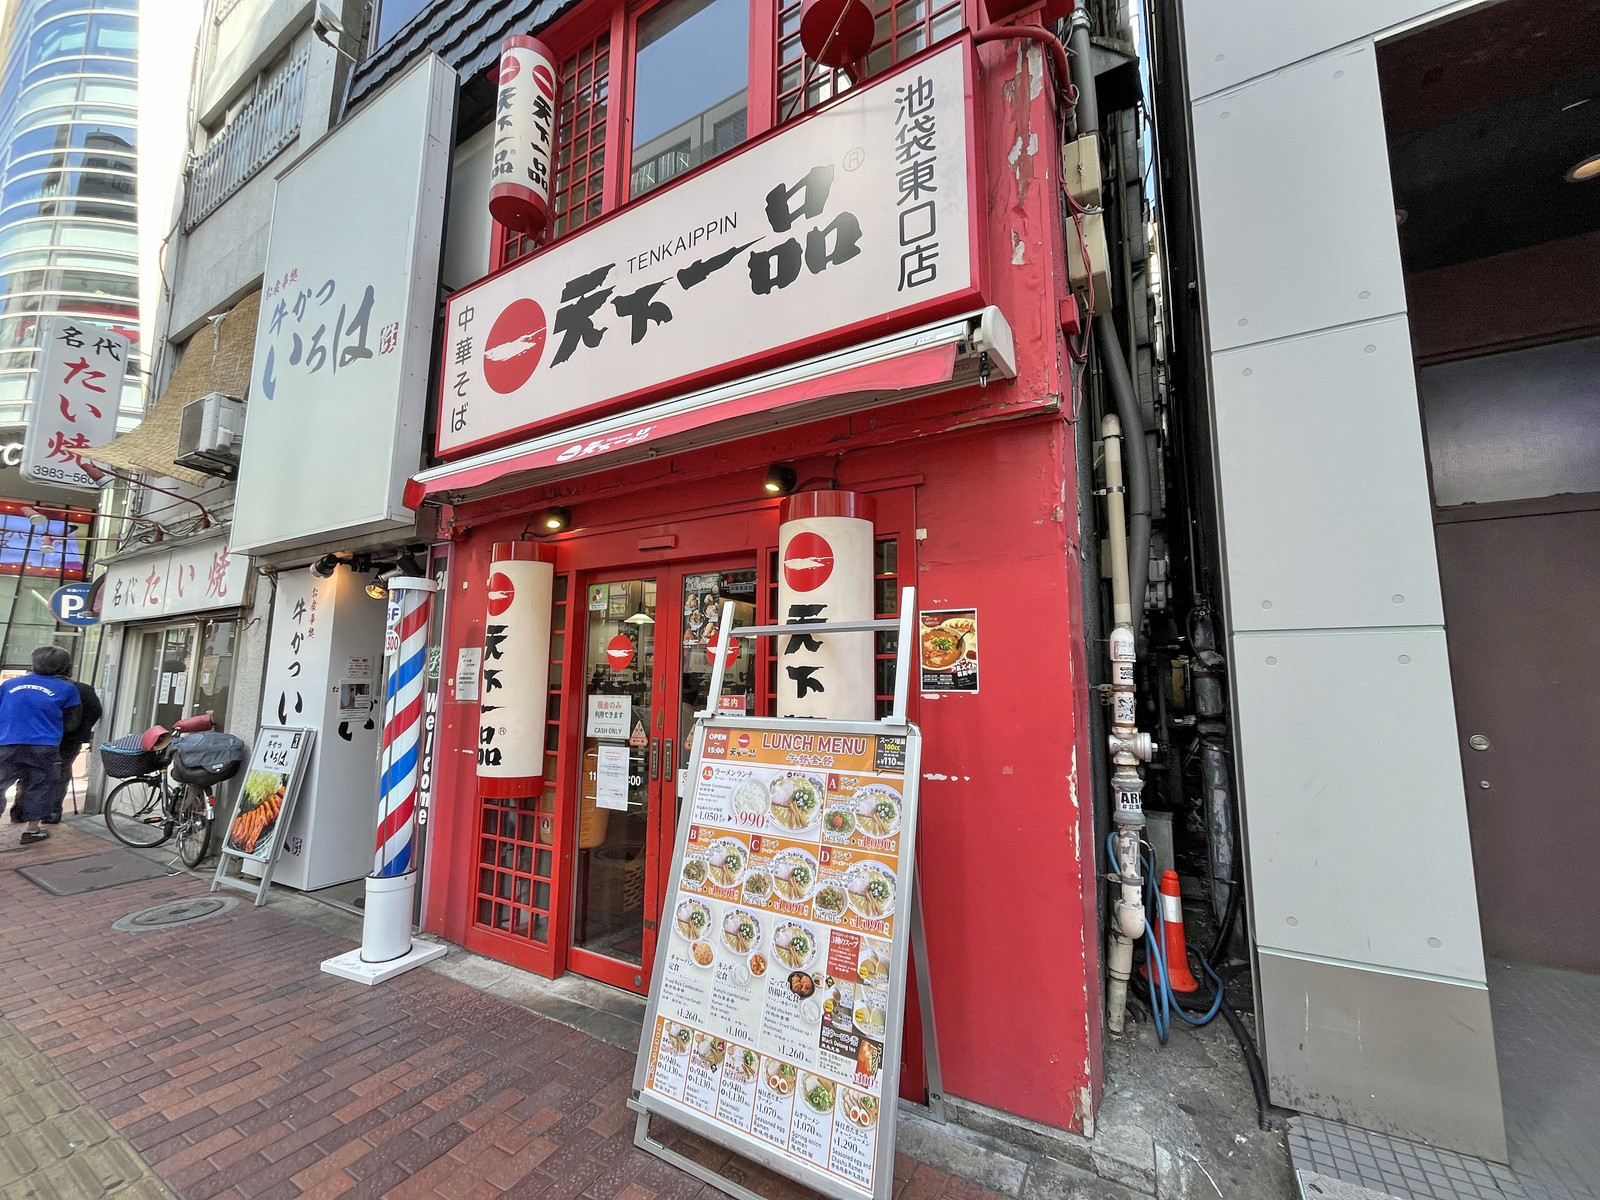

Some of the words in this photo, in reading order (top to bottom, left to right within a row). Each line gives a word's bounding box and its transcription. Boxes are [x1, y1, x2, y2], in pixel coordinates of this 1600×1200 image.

[526, 94, 553, 194] 天下一品
[894, 75, 939, 293] 池袋東口店
[626, 211, 739, 275] TENKAIPPIN
[549, 163, 863, 369] 天下一品
[268, 278, 336, 338] 牛かつ
[55, 326, 122, 362] 名代
[450, 304, 476, 434] 中華そば
[44, 356, 107, 470] たい焼
[60, 594, 84, 619] P
[597, 701, 622, 710] 現金のみ
[609, 727, 622, 735] ONLY
[707, 746, 725, 754] 15:00
[762, 733, 813, 752] LUNCH
[818, 737, 867, 755] MENU
[884, 743, 901, 751] 100cc
[418, 692, 437, 826] Welcome
[715, 768, 754, 778] ラーメンランチ
[828, 778, 837, 789] A
[690, 830, 697, 840] B
[751, 840, 759, 850] C
[820, 851, 829, 862] D
[670, 954, 694, 967] チャーハン
[718, 962, 733, 972] キムチ
[768, 977, 791, 990] こってり
[765, 1003, 777, 1012] Fried
[757, 1095, 773, 1105] ラーメン
[754, 1114, 776, 1128] Seasoned
[776, 1123, 786, 1134] egg
[794, 1111, 820, 1126] ねぎラーメン
[754, 1121, 770, 1132] Ramen
[791, 1138, 808, 1149] Ramen
[792, 1130, 808, 1144] Spring
[808, 1138, 822, 1149] onion
[834, 1128, 870, 1148] チャーシューメン
[832, 1148, 854, 1163] Seasoned
[854, 1156, 863, 1167] egg
[863, 1161, 871, 1170] and
[848, 1163, 864, 1174] Ramen
